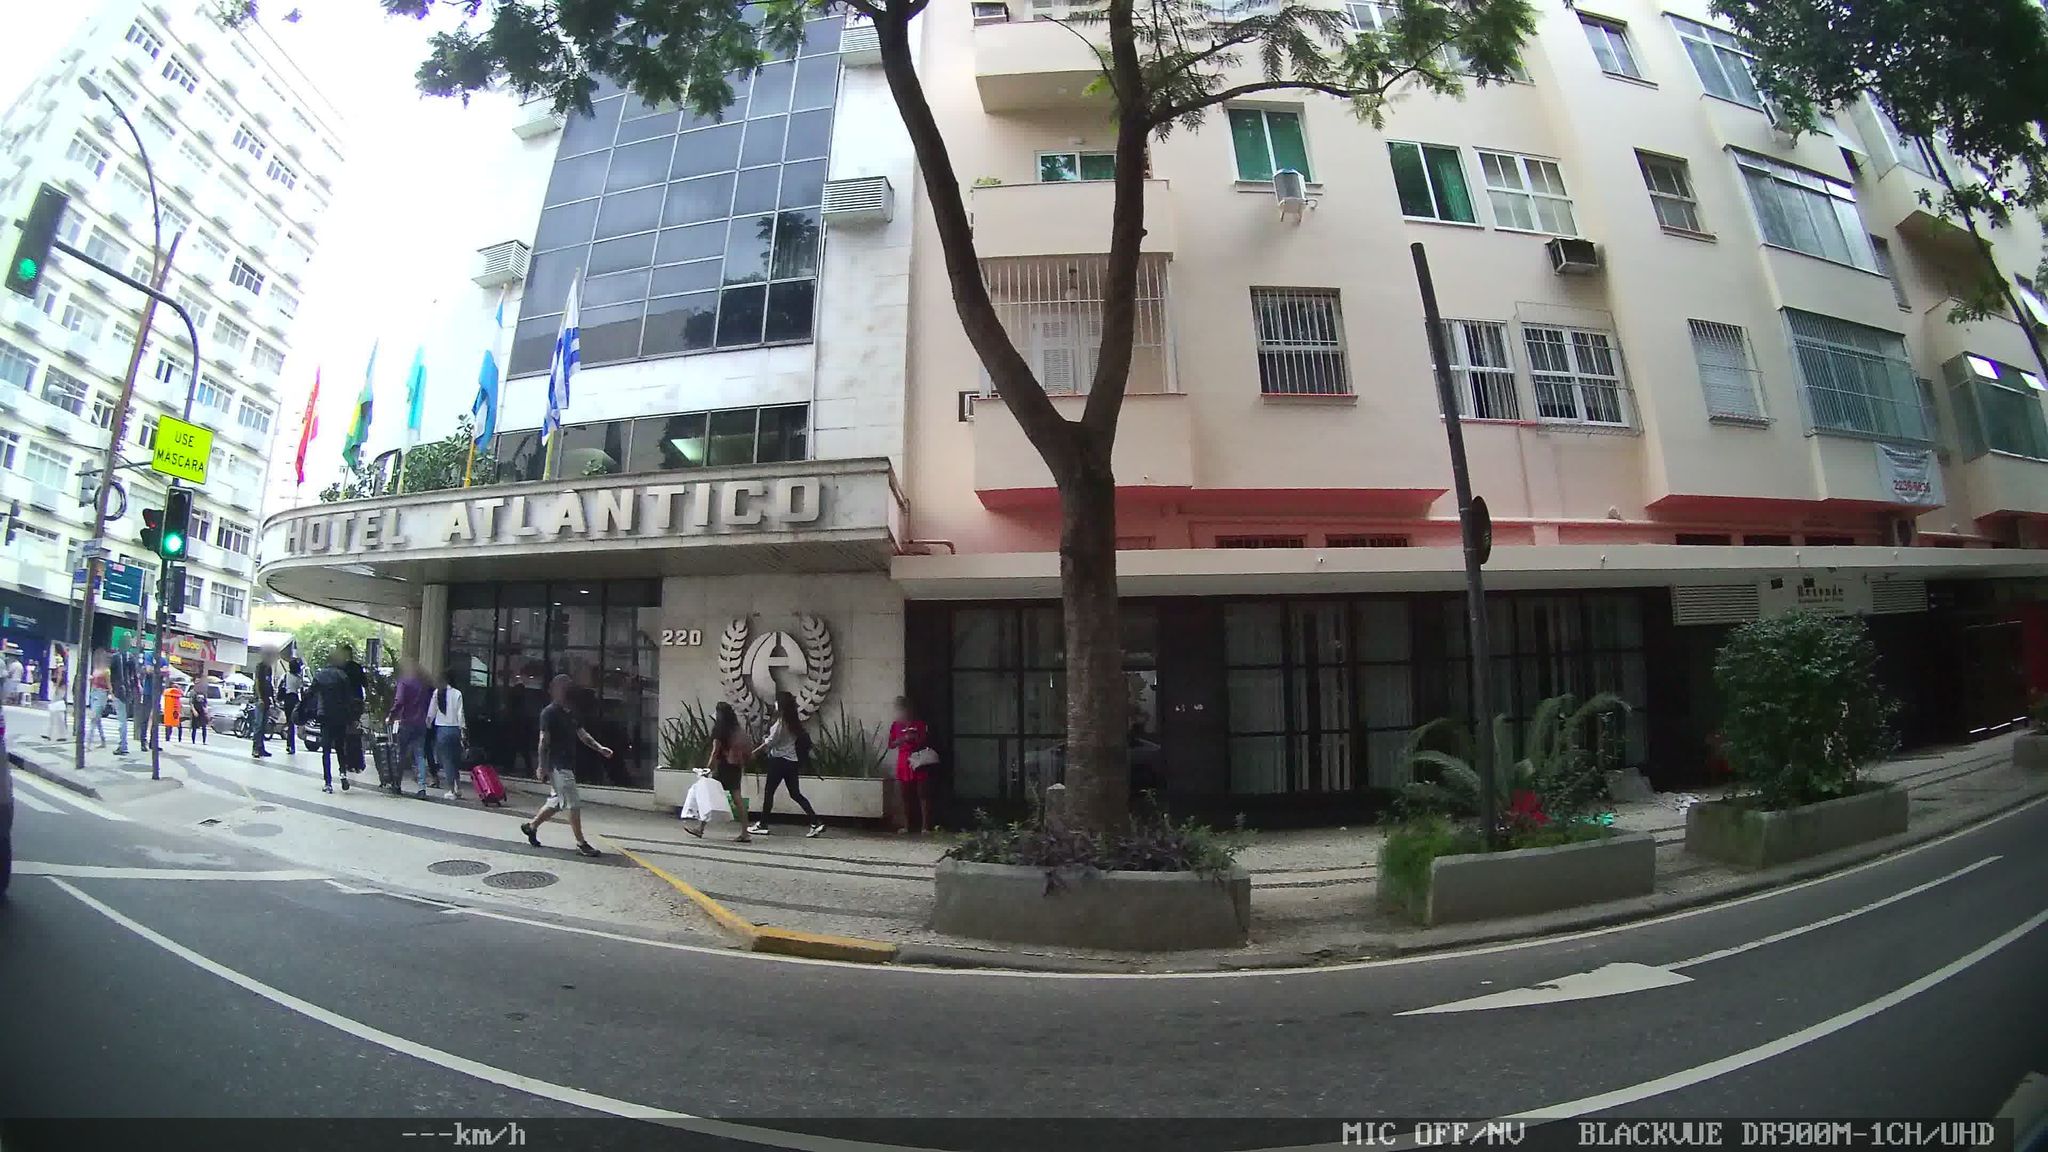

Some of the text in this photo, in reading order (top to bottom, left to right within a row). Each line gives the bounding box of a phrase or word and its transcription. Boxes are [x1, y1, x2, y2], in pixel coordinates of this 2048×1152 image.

[174, 430, 195, 448] USE
[284, 508, 405, 554] HOTEL
[661, 629, 702, 647] 220
